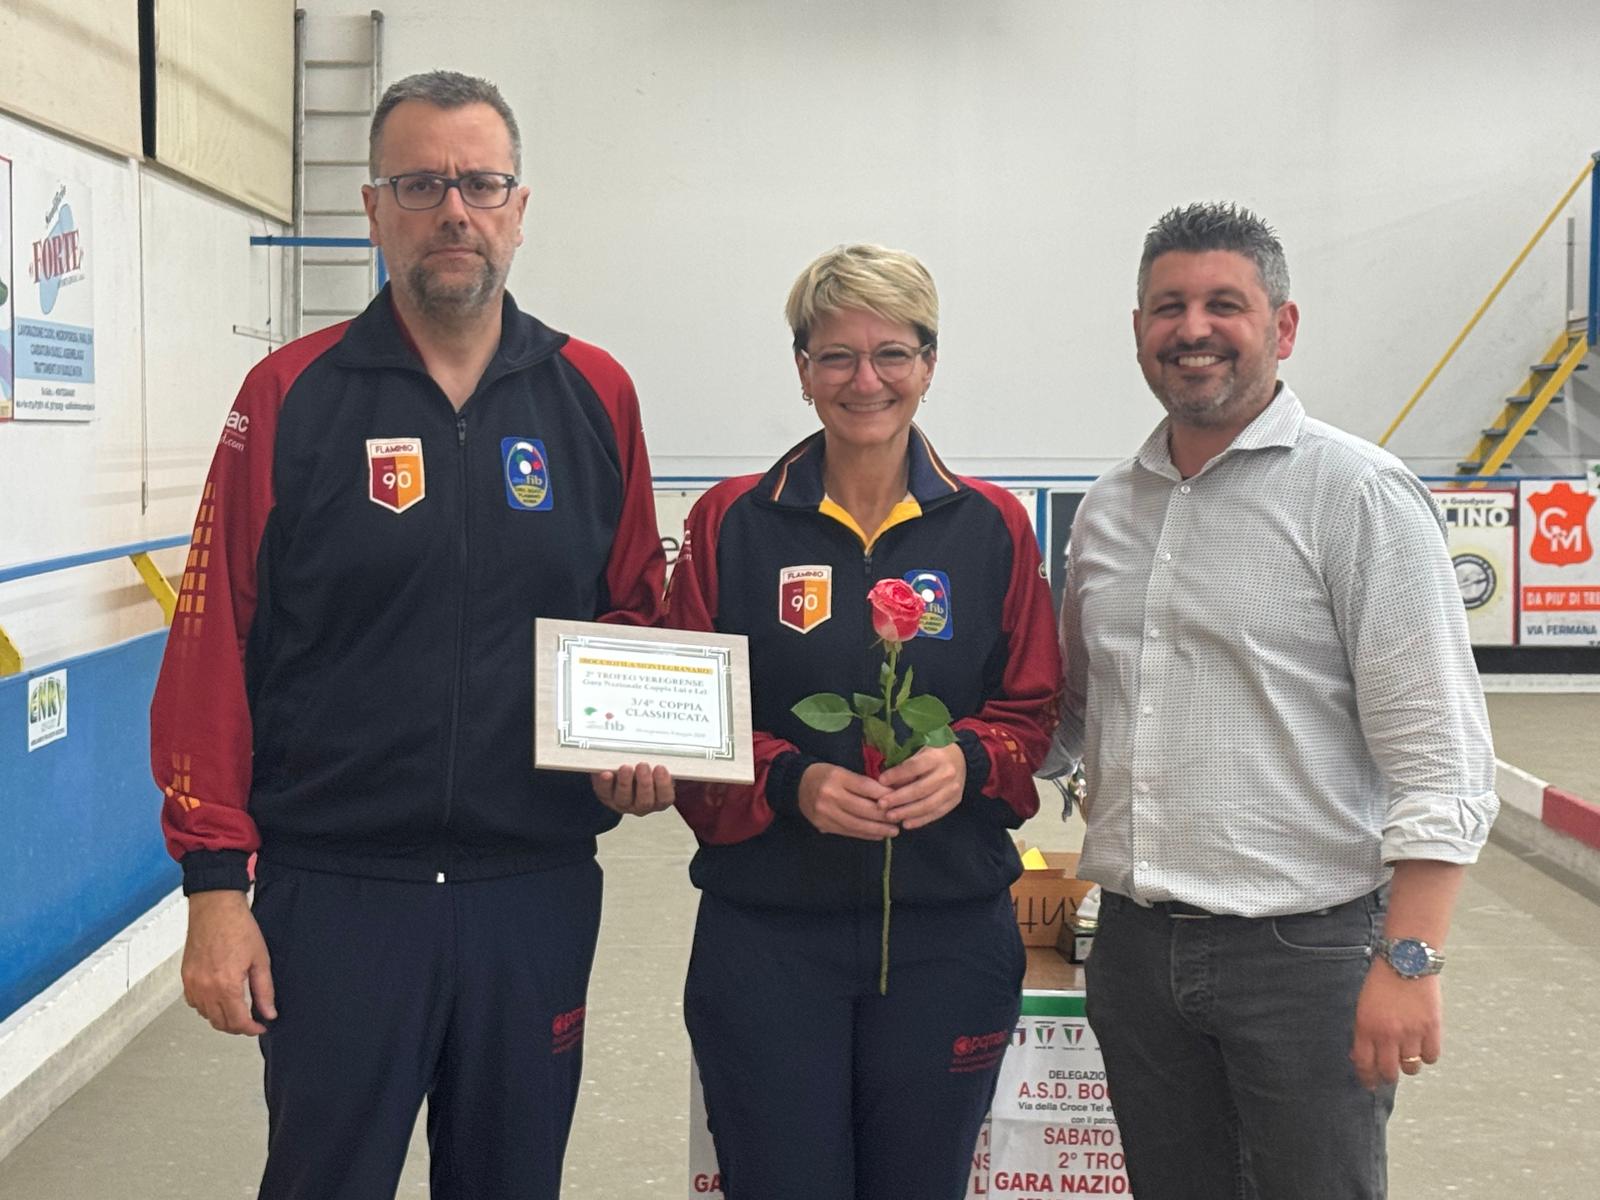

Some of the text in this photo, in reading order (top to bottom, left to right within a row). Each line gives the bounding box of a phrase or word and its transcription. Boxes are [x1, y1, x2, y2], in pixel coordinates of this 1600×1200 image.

[33, 230, 80, 283] FORTE
[375, 445, 414, 454] FLAMINIO
[383, 471, 412, 489] 90
[1450, 495, 1495, 505] Goodyear
[788, 571, 823, 579] FLAMINIO
[791, 594, 818, 612] 90
[1527, 624, 1543, 635] VIA
[597, 672, 637, 681] TROFEO
[640, 675, 704, 687] VEREGRENSE
[605, 680, 641, 690] Nazionale
[644, 683, 671, 693] Coppia
[659, 700, 702, 711] COPPIA
[625, 708, 709, 722] CLASSIFICATA
[1049, 1070, 1106, 1080] DELEGAZIO
[1018, 1082, 1111, 1100] A.S.D. BO
[1018, 1102, 1033, 1111] Via
[1035, 1102, 1057, 1111] della
[1060, 1103, 1088, 1112] Croce
[1090, 1103, 1104, 1112] Tel
[1044, 1128, 1114, 1146] SABATO
[1058, 1152, 1125, 1170] 2° TRO
[995, 1172, 1132, 1195] GARA NAZIO
